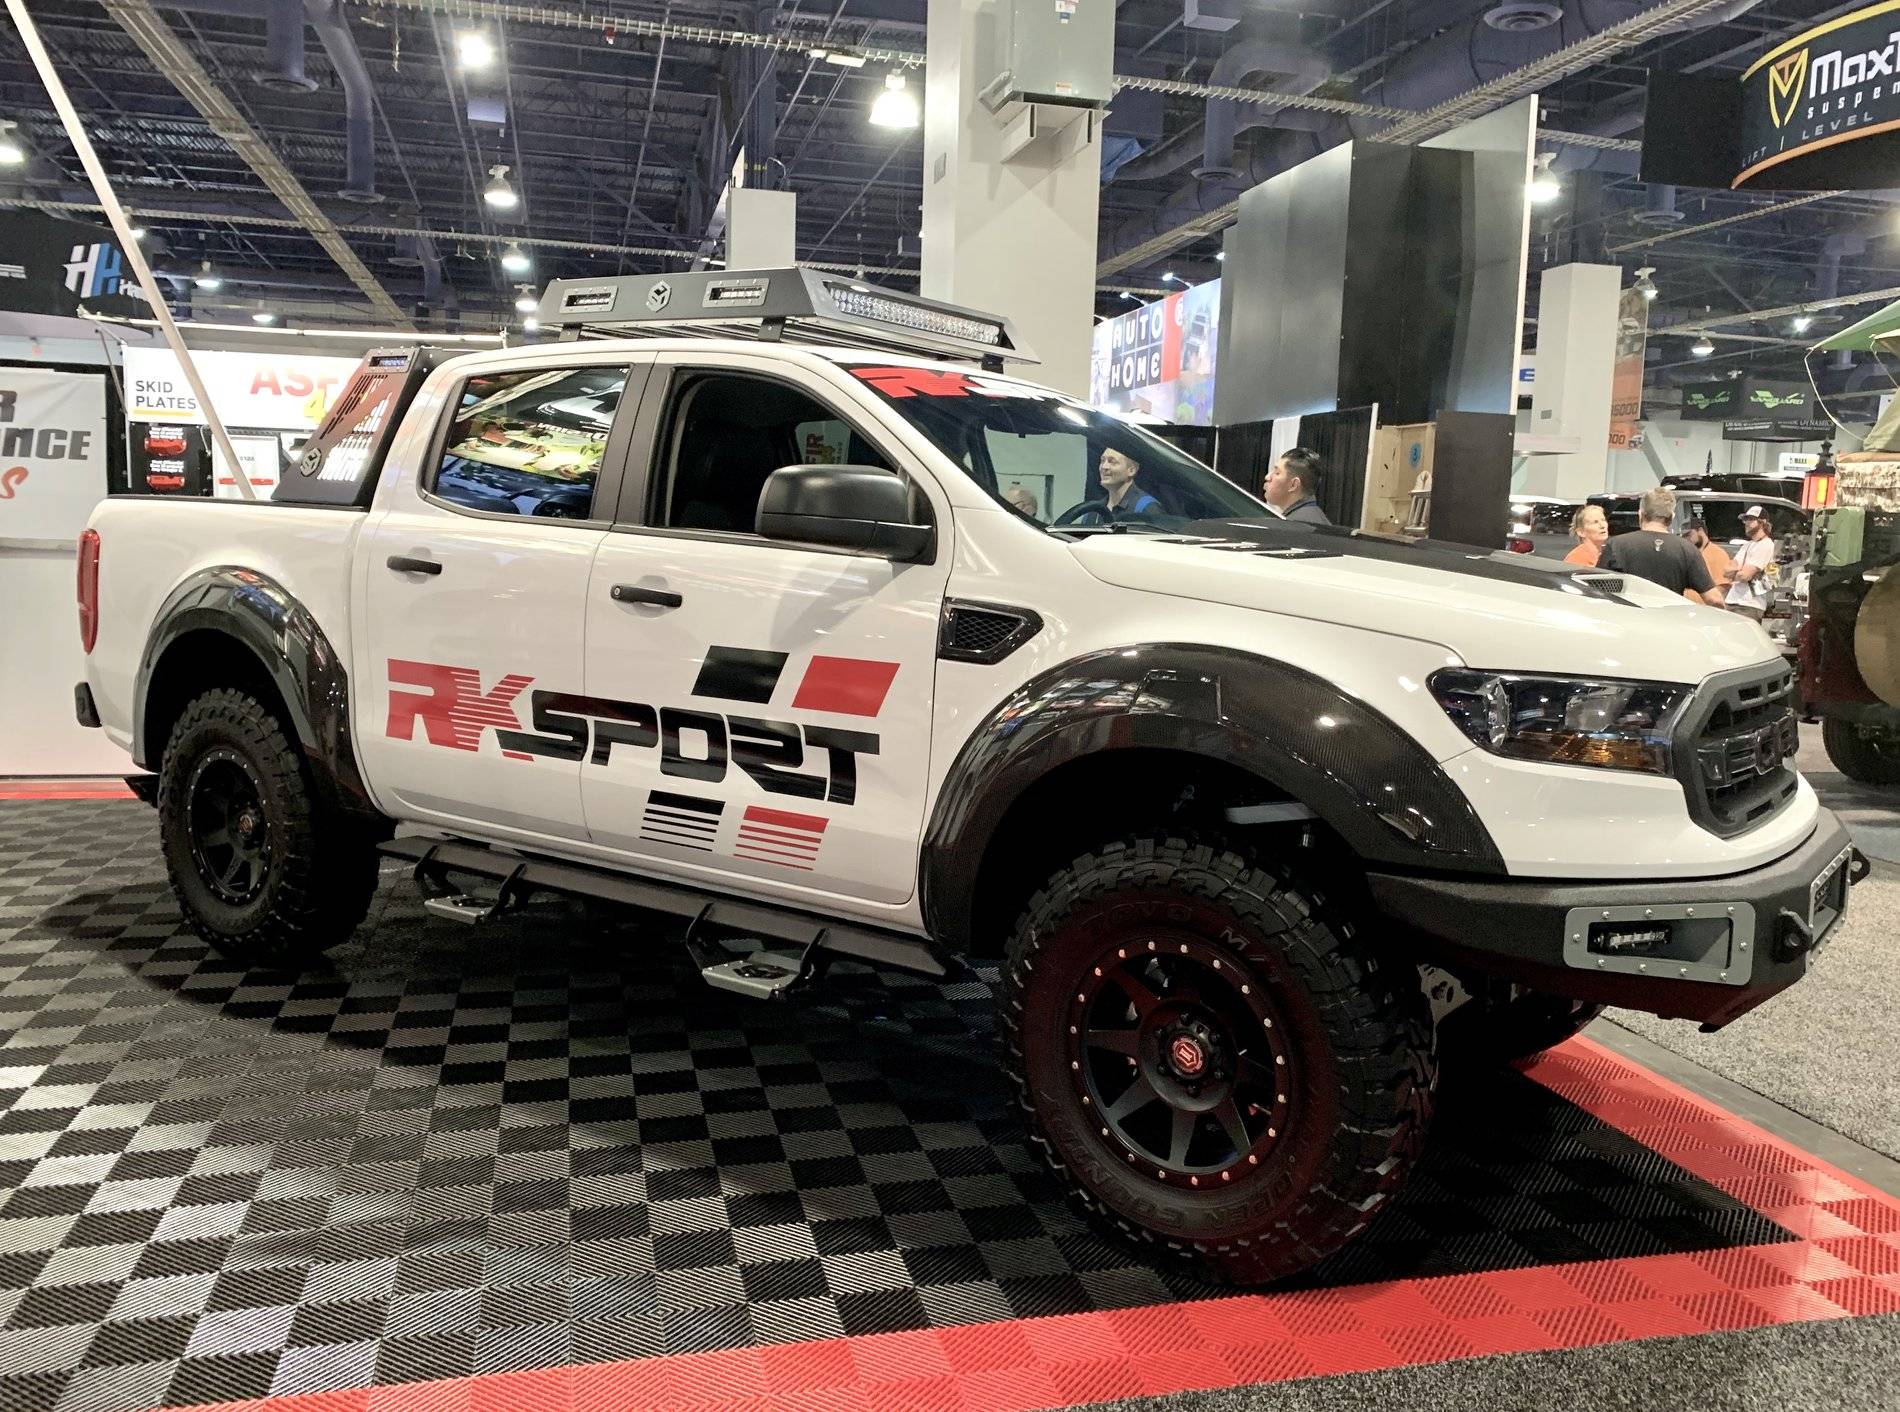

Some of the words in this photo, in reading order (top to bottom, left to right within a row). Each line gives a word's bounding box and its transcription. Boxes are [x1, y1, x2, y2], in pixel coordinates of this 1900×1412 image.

[1802, 111, 1874, 141] LEVEL
[1112, 305, 1164, 350] AUTO
[1111, 351, 1160, 389] HOME
[135, 380, 173, 393] SKID
[135, 396, 197, 410] PLATES
